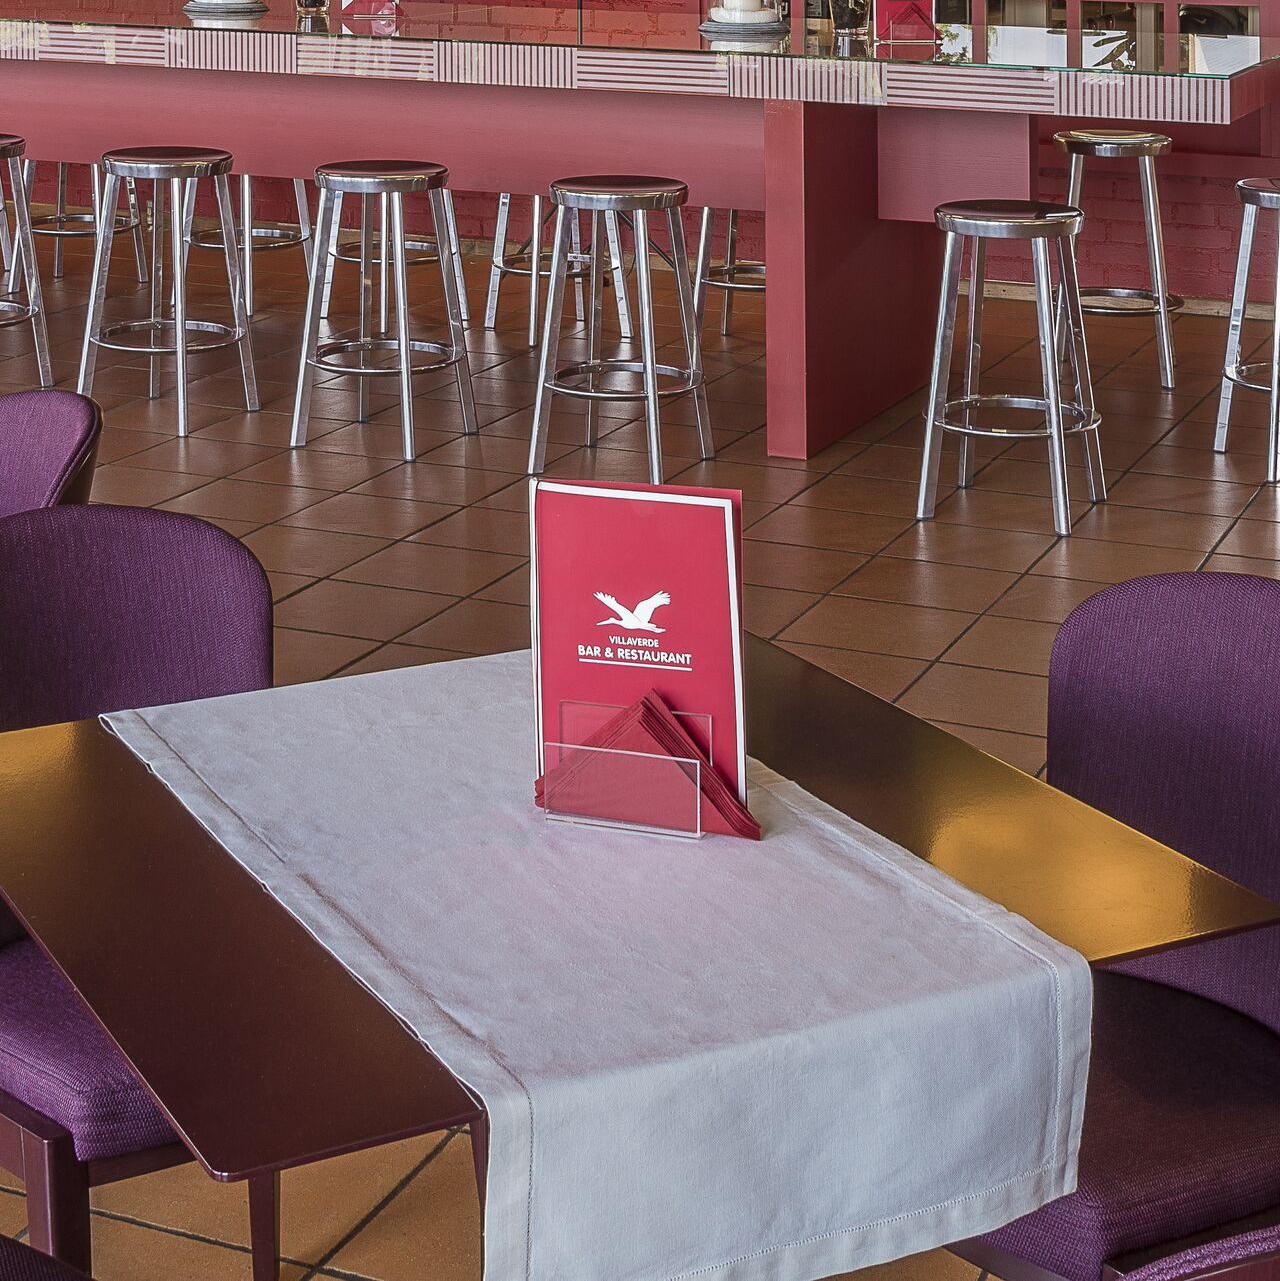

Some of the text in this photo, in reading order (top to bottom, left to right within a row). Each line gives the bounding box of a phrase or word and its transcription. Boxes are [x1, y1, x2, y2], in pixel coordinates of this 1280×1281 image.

[609, 635, 659, 648] VILLAVERDE
[577, 644, 692, 665] BAR & RESTAURANT
